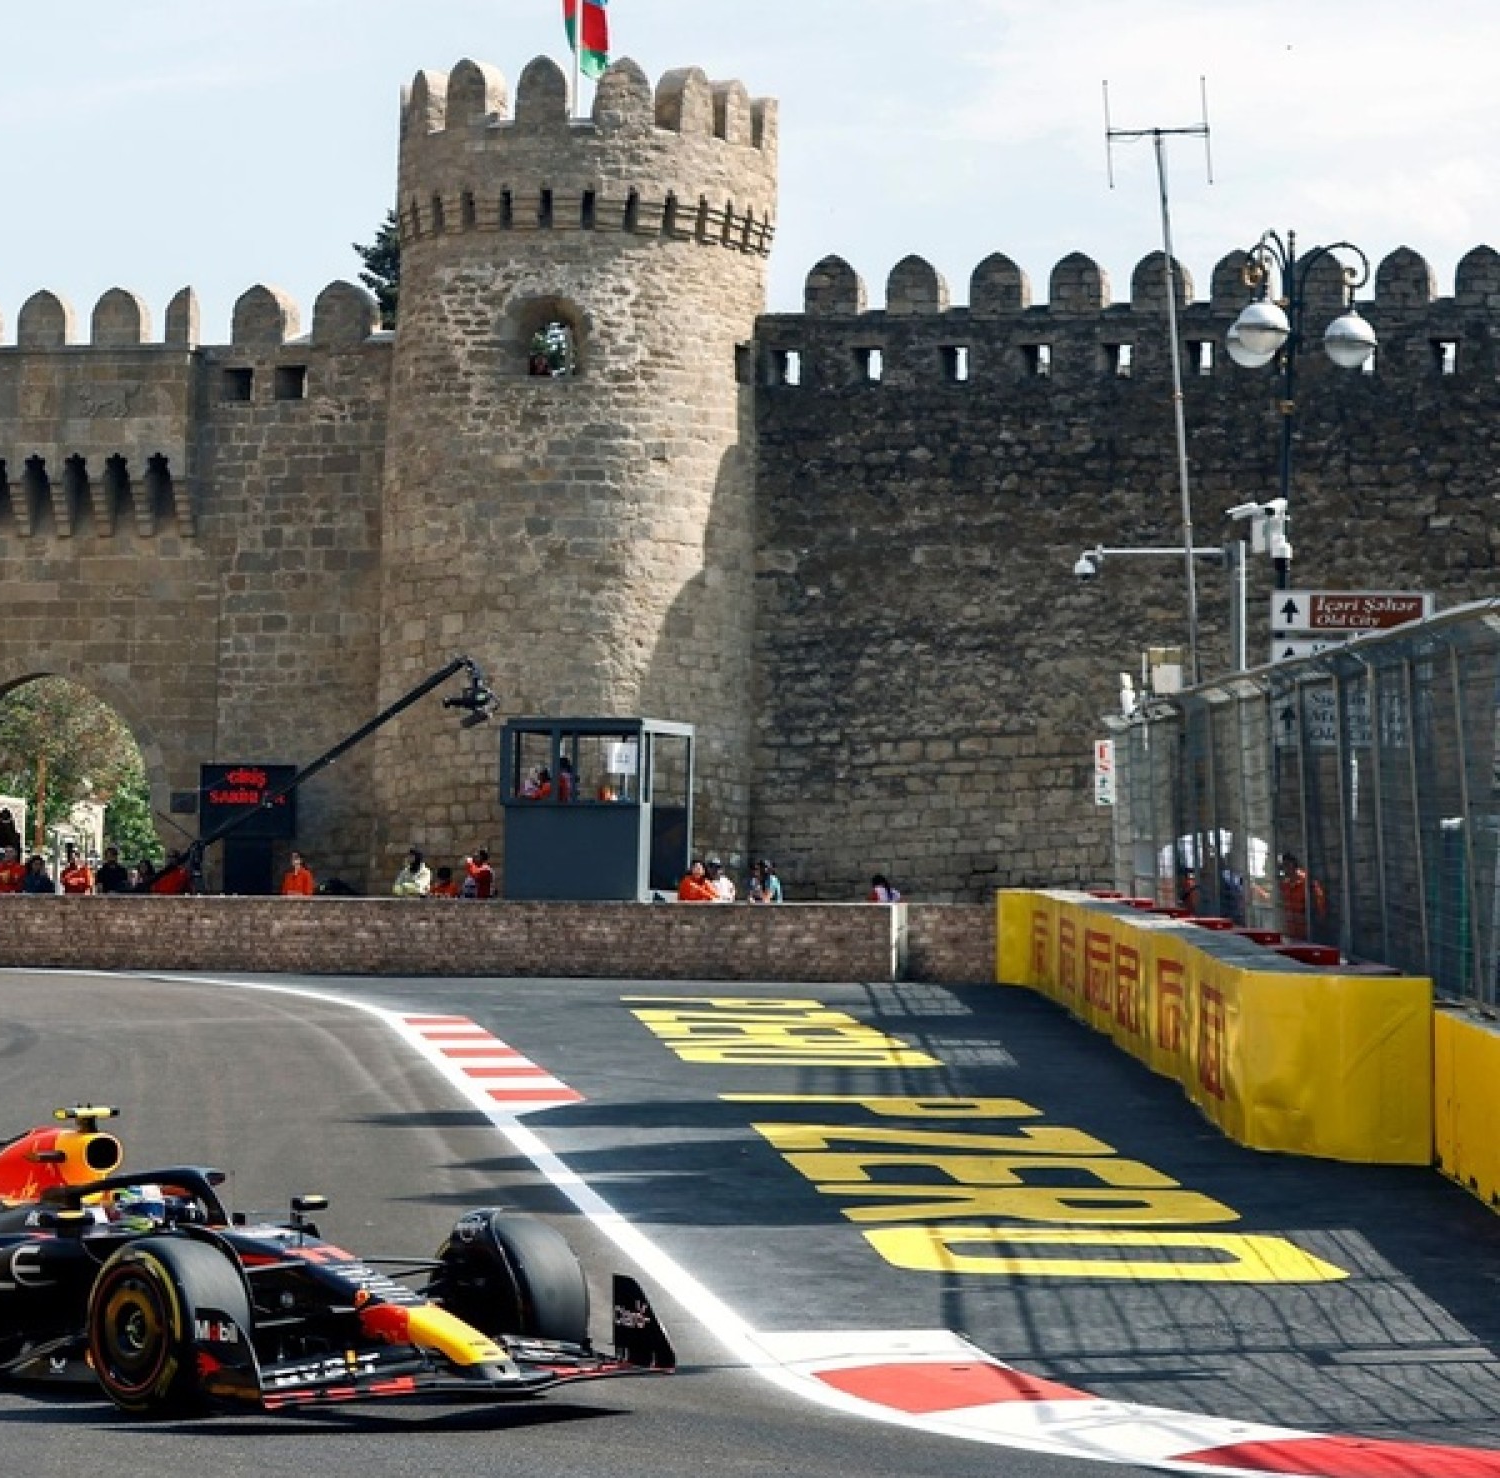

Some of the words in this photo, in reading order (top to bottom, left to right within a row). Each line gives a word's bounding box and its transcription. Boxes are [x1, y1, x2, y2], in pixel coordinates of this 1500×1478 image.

[1316, 614, 1346, 626] Old
[1349, 614, 1381, 628] City
[750, 1122, 1352, 1282] ZERO
